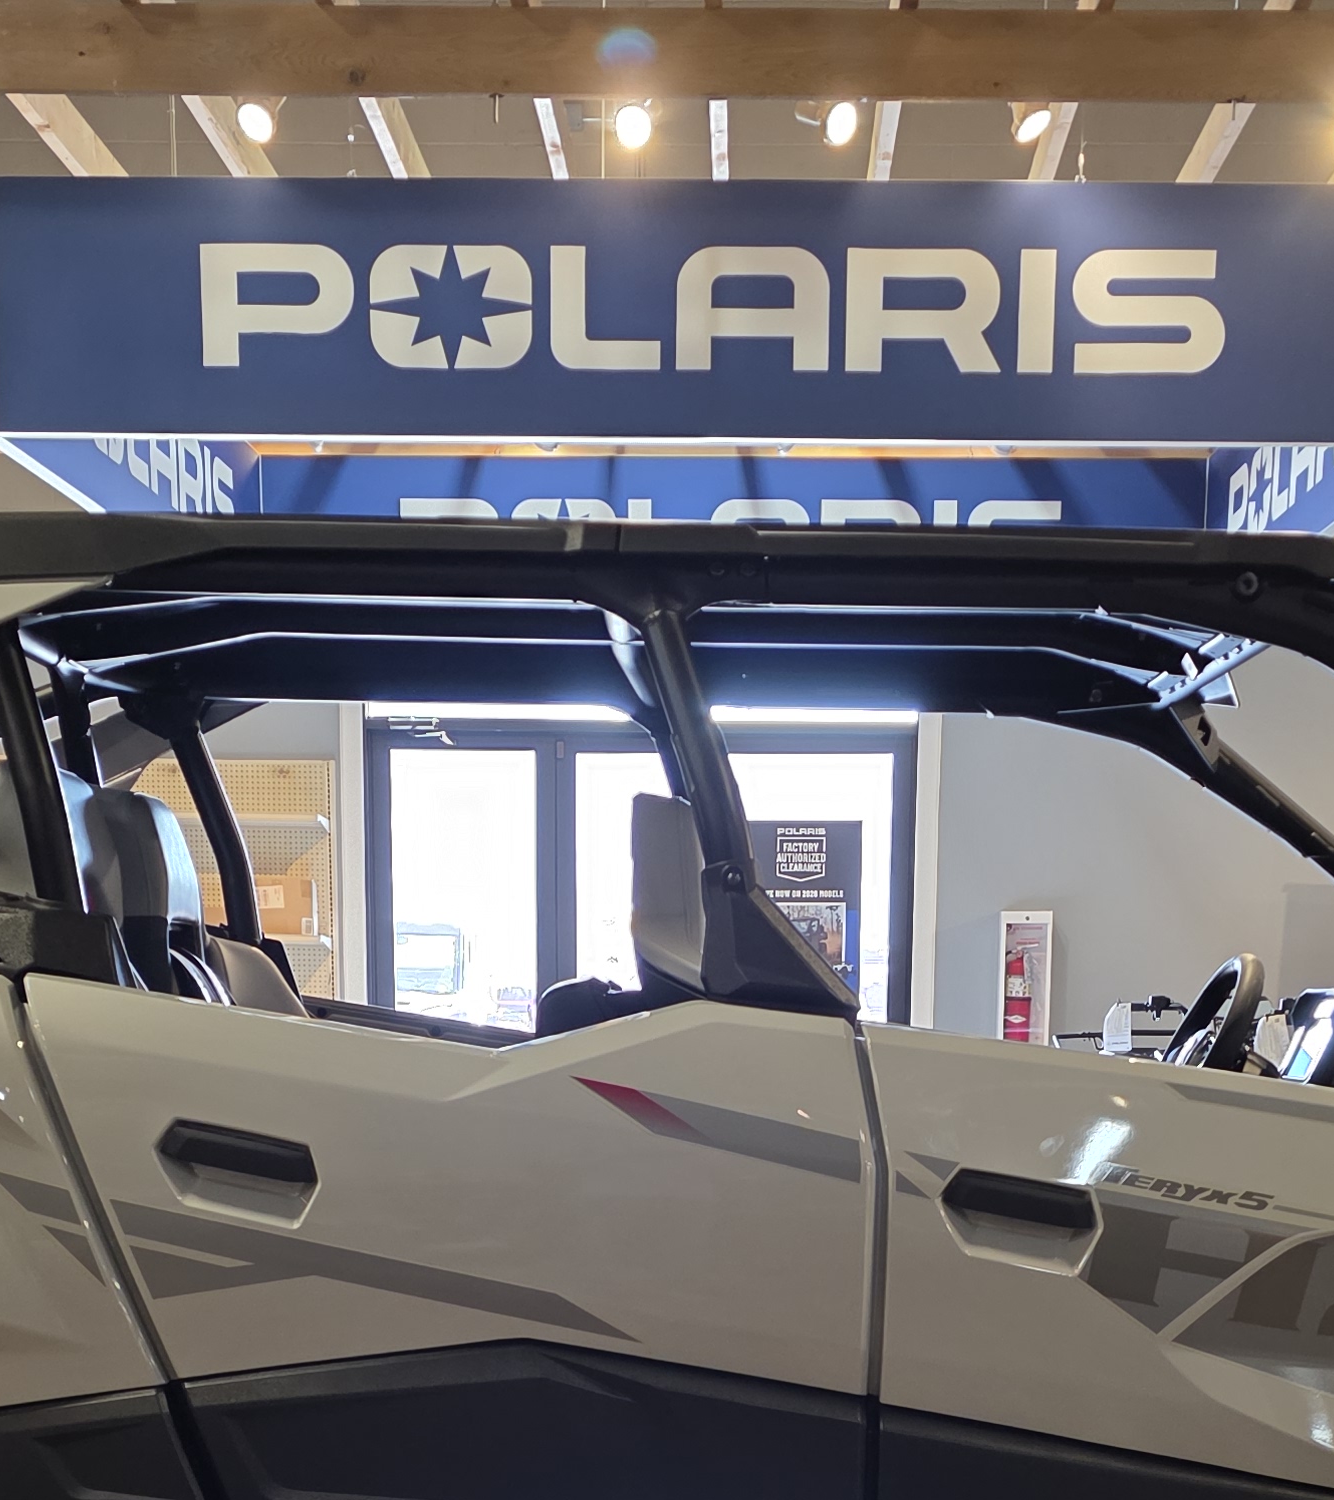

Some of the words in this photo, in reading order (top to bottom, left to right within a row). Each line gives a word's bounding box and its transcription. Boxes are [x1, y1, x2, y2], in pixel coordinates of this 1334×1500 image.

[199, 242, 1227, 374] POLARIS
[776, 827, 826, 835] POLARIS
[783, 842, 819, 852] FACTORY
[776, 852, 826, 863] AUTHORIZED
[780, 863, 822, 872] CLEARANCE
